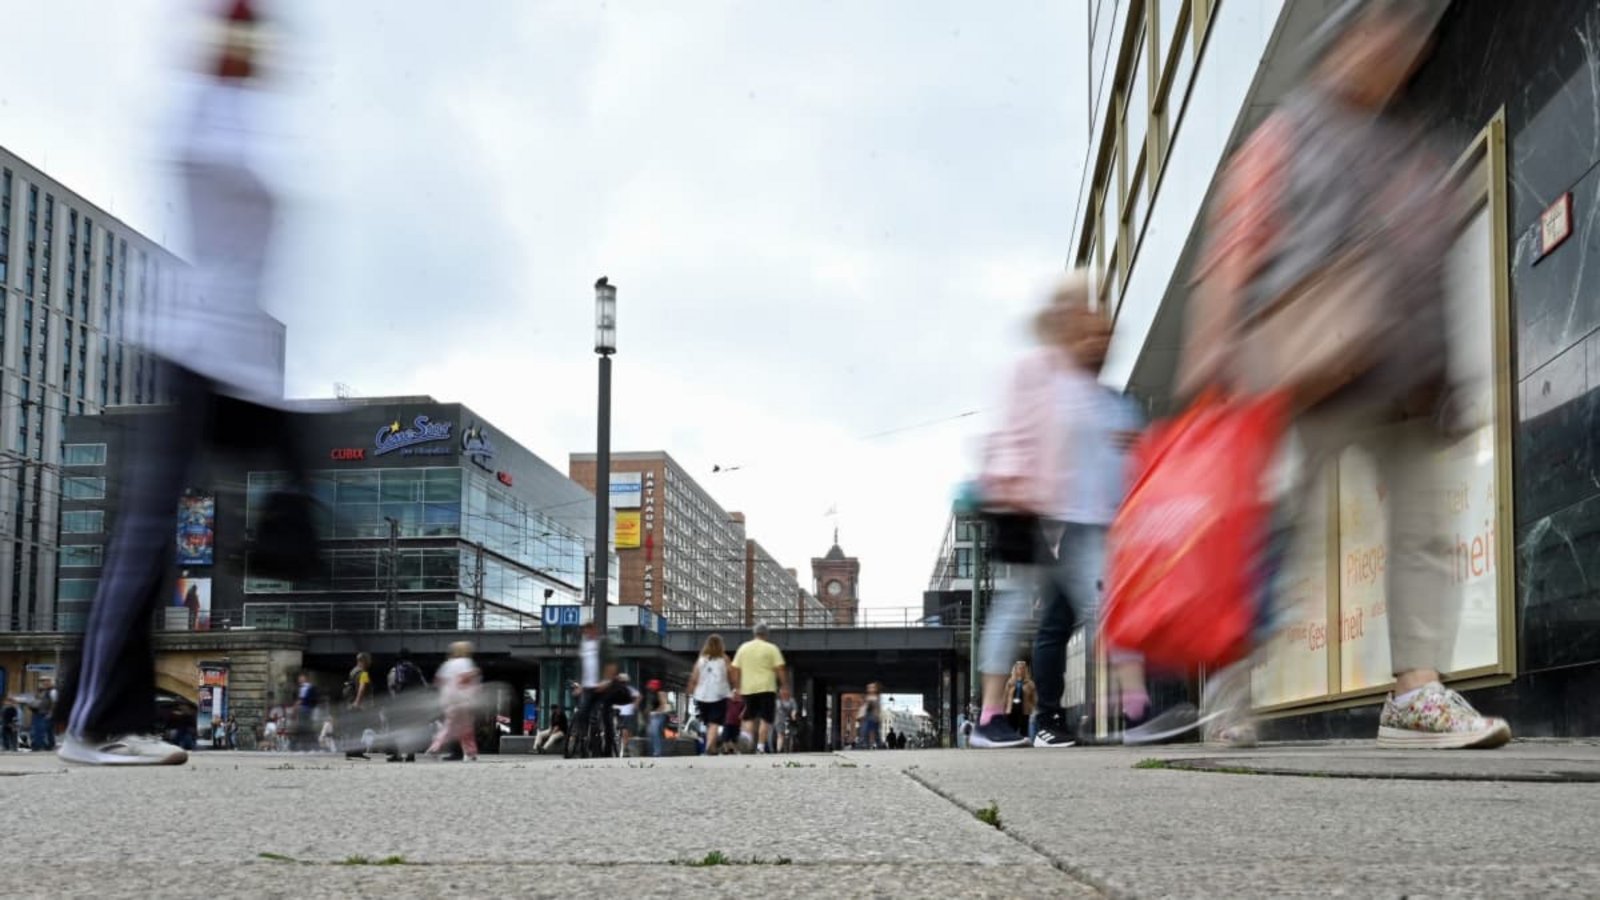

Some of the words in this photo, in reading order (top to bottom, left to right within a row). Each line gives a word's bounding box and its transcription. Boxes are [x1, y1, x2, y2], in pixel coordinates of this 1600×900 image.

[330, 448, 364, 460] CUBIX
[645, 471, 654, 530] RATHAUS
[645, 565, 653, 606] PASSA
[545, 607, 559, 625] U
